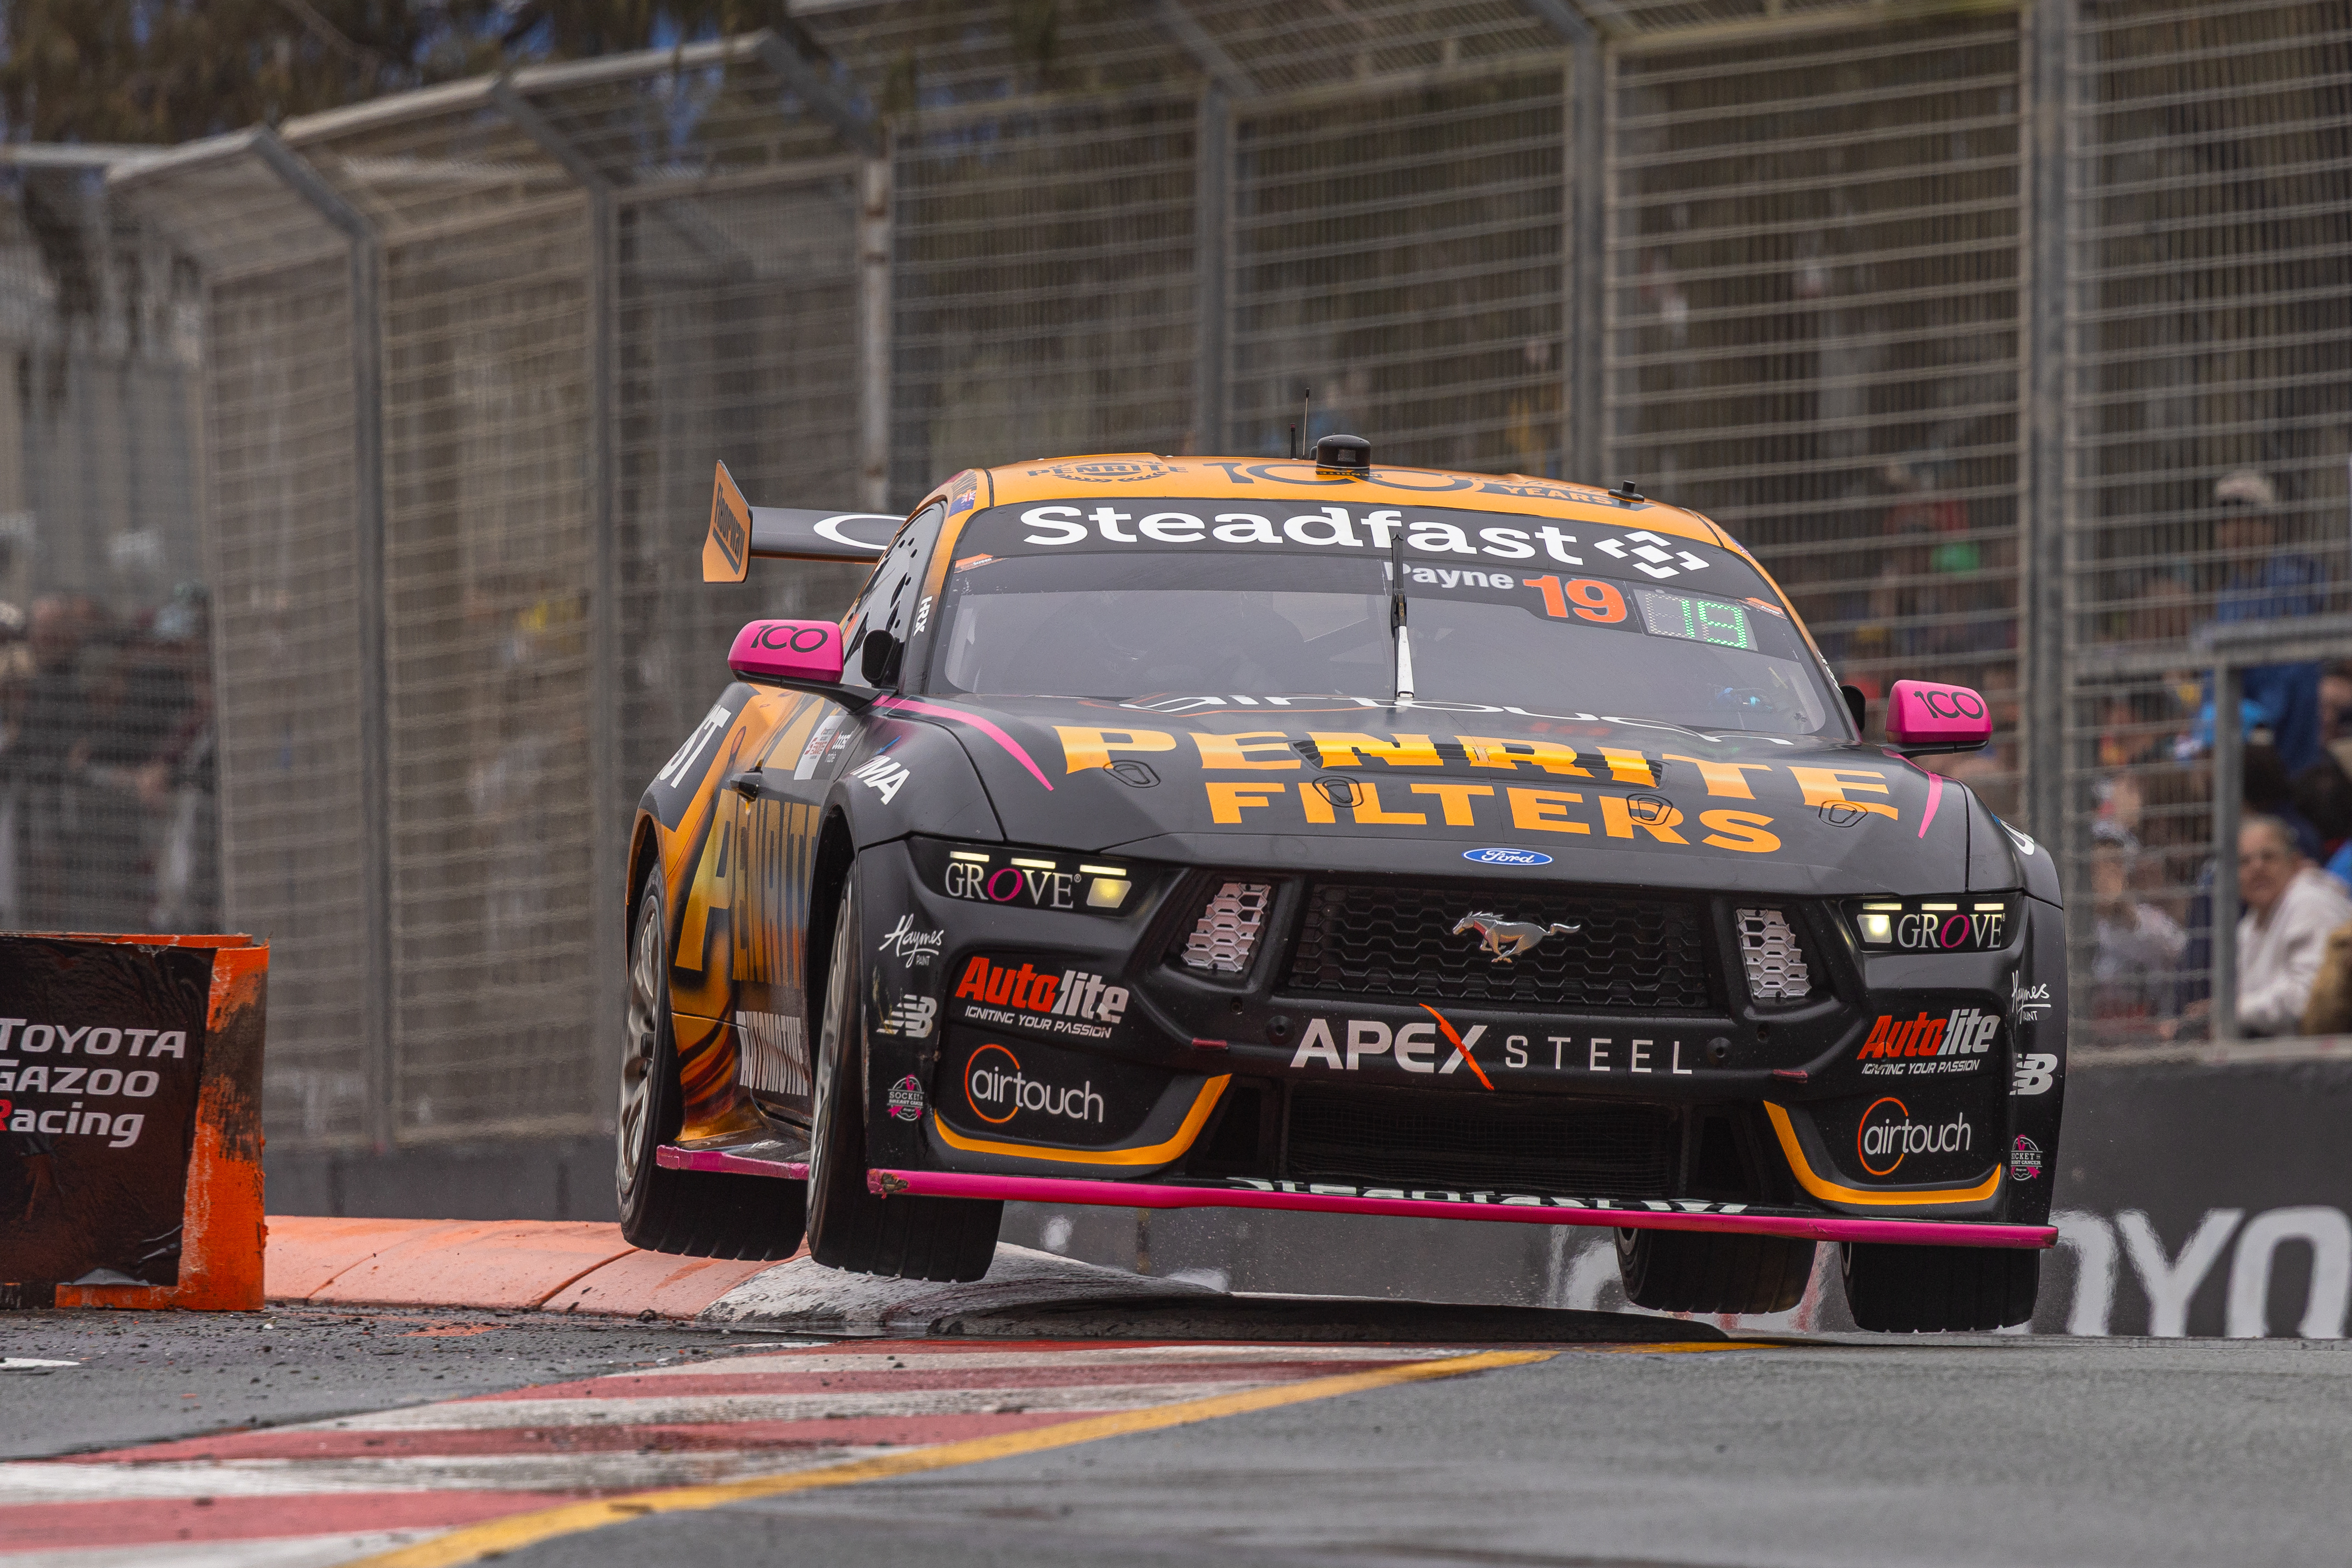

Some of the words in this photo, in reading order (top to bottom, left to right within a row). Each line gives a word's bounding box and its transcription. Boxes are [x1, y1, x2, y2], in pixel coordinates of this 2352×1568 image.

[1027, 462, 1189, 477] PENRITE
[1501, 486, 1613, 505] YEARS
[1020, 505, 1583, 565] Steadfast
[913, 595, 933, 637] HRX
[1523, 574, 1627, 623] 19
[751, 624, 828, 653] 100
[1681, 600, 1747, 648] 19
[1914, 691, 1984, 719] 100
[1055, 725, 1899, 821] PENRITE
[1206, 782, 1781, 853] FILTERS
[1481, 850, 1535, 863] Ford
[945, 862, 1074, 909] GROVE
[879, 913, 944, 968] Haymes
[1898, 913, 2003, 949] GROVE
[956, 957, 1129, 1024] Autolite
[2012, 970, 2050, 1025] Haymes
[0, 1019, 187, 1059] TOYOTA
[965, 1005, 1013, 1024] IGNITING
[1018, 1014, 1051, 1030] YOUR
[1054, 1020, 1112, 1038] PASSION
[1857, 1008, 2001, 1060] Autolite
[1290, 1004, 1494, 1090] APEX
[1505, 1035, 1693, 1075] STEEL
[1862, 1063, 1904, 1075] IGNITING
[1908, 1062, 1935, 1074] YOUR
[1937, 1059, 1981, 1073] PASSION
[972, 1066, 1102, 1123] airtouch
[1864, 1112, 1972, 1155] airtouch
